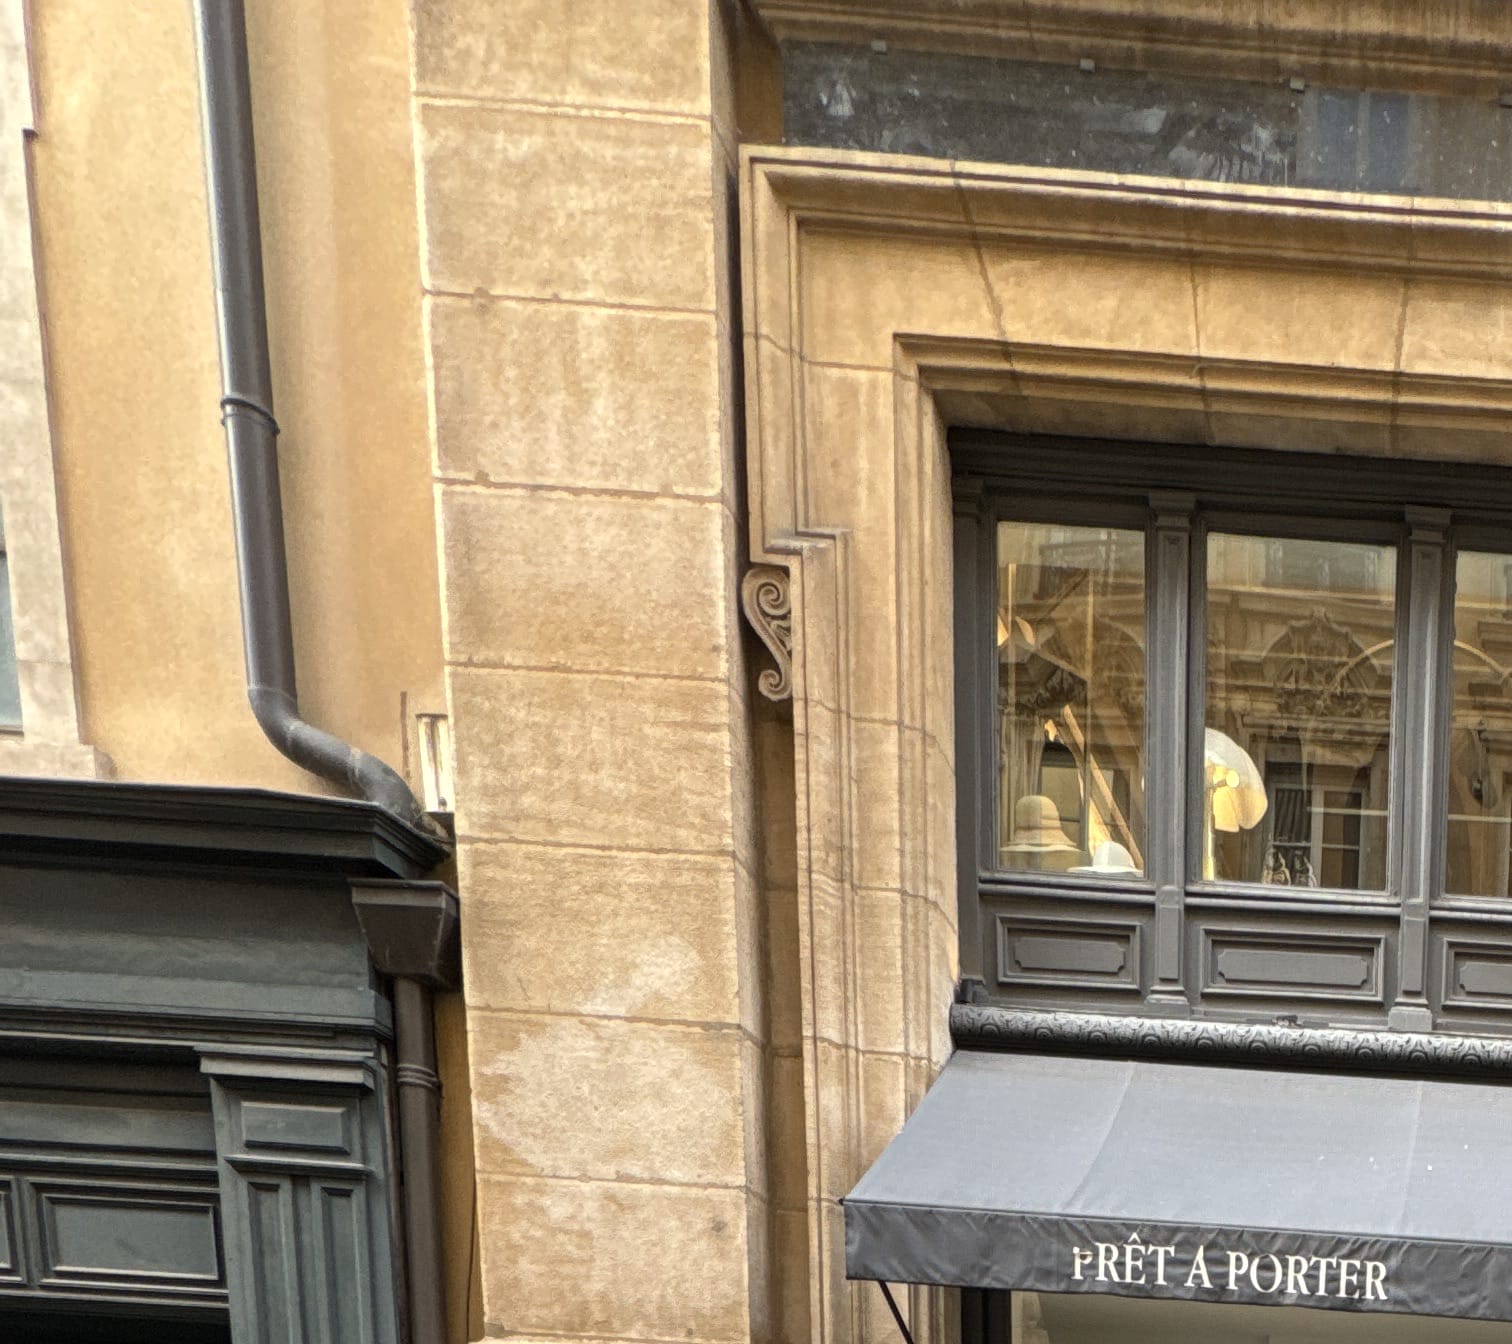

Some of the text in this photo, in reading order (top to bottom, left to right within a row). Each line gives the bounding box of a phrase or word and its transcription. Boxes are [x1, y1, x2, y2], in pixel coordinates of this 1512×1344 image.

[1071, 1231, 1388, 1301] PRÊT A PORTER
